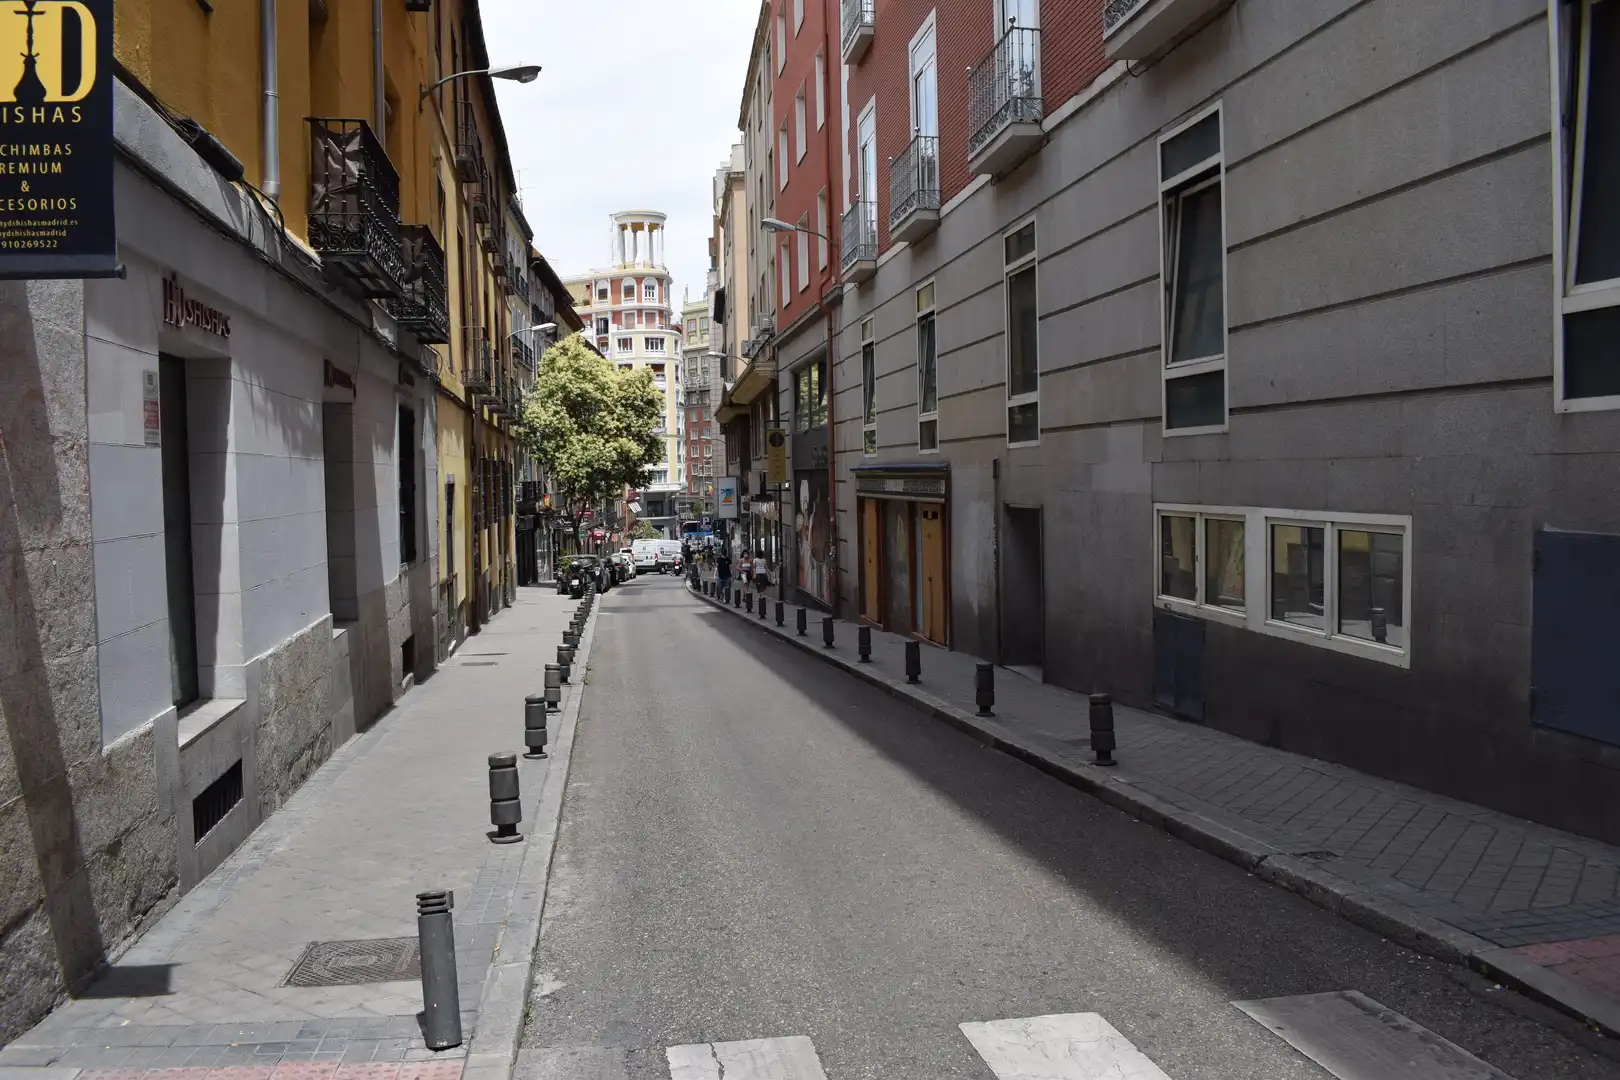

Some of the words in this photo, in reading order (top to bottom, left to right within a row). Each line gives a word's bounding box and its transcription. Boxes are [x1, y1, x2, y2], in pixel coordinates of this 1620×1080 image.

[20, 180, 30, 193] &
[1, 240, 58, 249] 910269522
[703, 517, 709, 525] P
